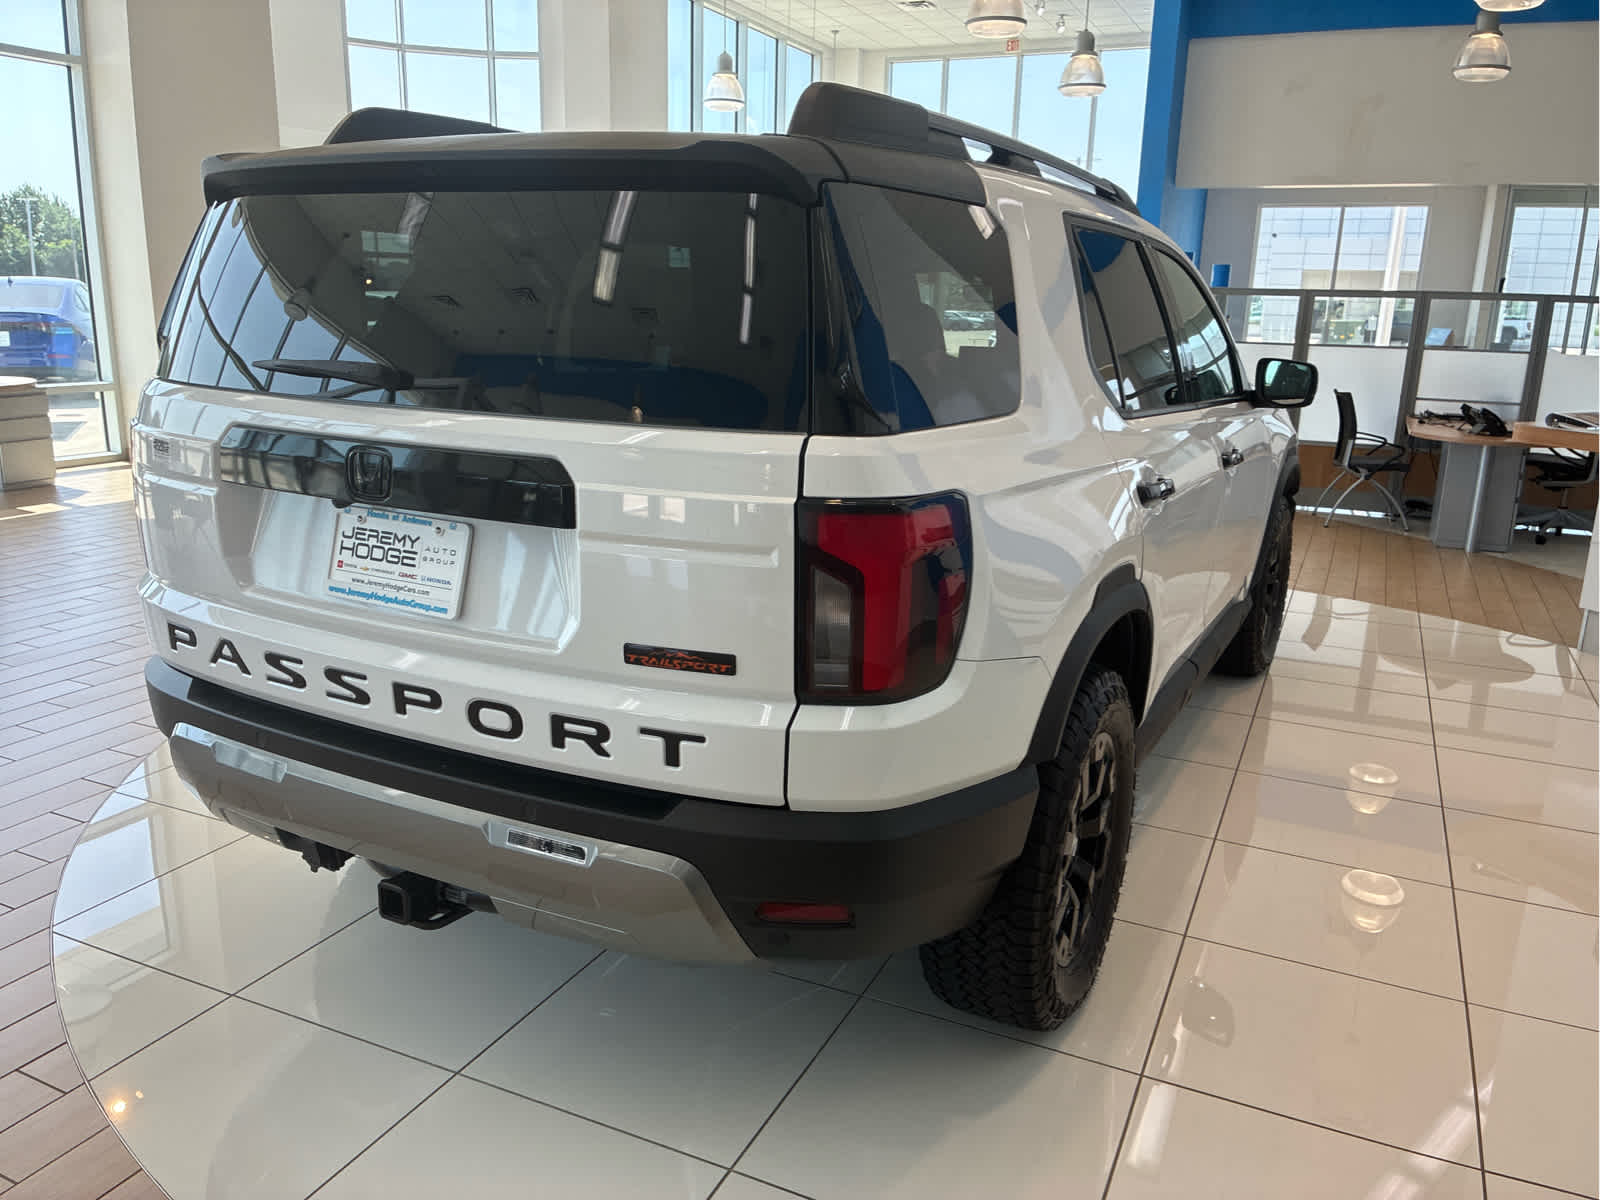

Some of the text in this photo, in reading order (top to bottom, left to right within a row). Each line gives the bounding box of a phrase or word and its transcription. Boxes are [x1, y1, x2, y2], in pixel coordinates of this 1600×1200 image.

[341, 526, 421, 549] JEREMY
[339, 540, 418, 568] HODGE
[422, 556, 456, 565] GROUP
[424, 546, 457, 556] AUTO
[351, 577, 430, 596] www.JeremyHodgeCars.com
[398, 571, 418, 580] GMC
[426, 577, 452, 586] HONDA
[328, 585, 448, 614] www.JeremyHodgeAutoGroup.com
[626, 654, 733, 674] TRAILSPORT
[167, 622, 707, 769] PASSPORT
